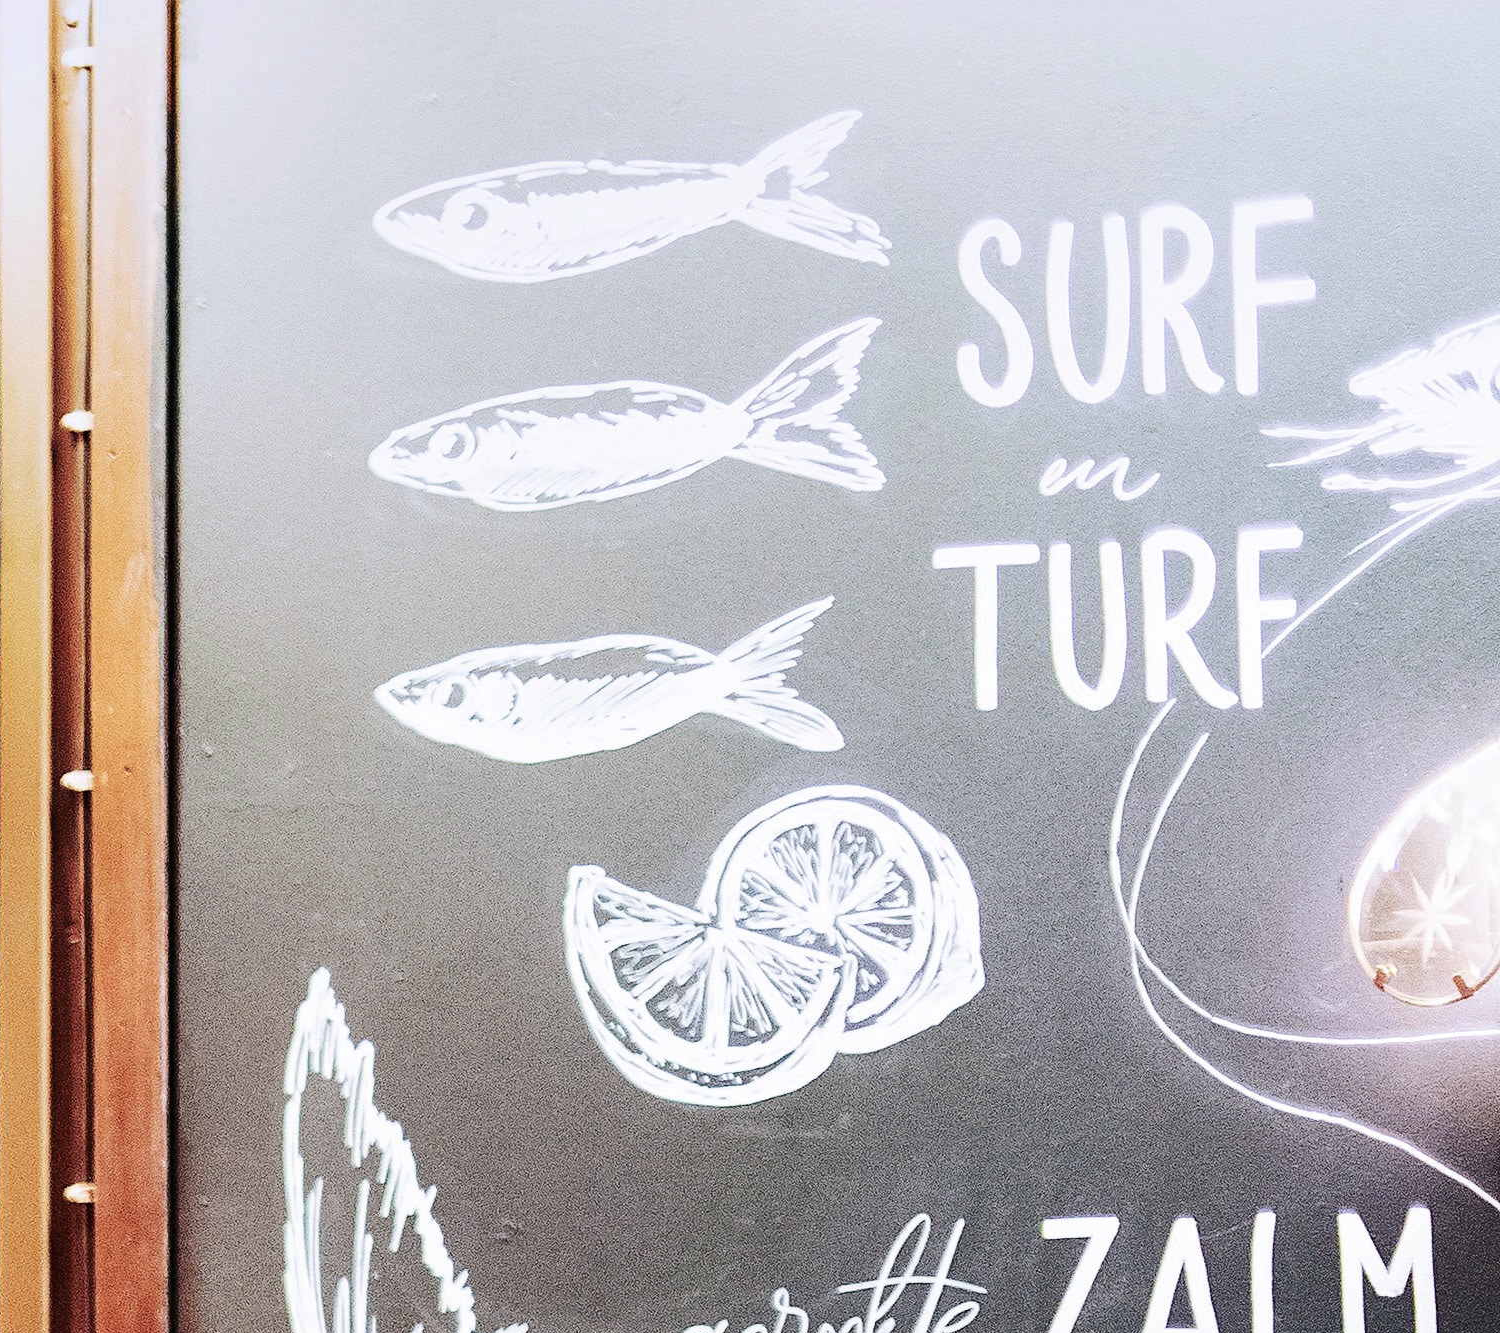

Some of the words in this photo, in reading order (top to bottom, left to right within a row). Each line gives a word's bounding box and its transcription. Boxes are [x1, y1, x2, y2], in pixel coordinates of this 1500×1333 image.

[956, 198, 1316, 408] SURF
[1039, 456, 1162, 501] en
[932, 525, 1304, 712] TURF
